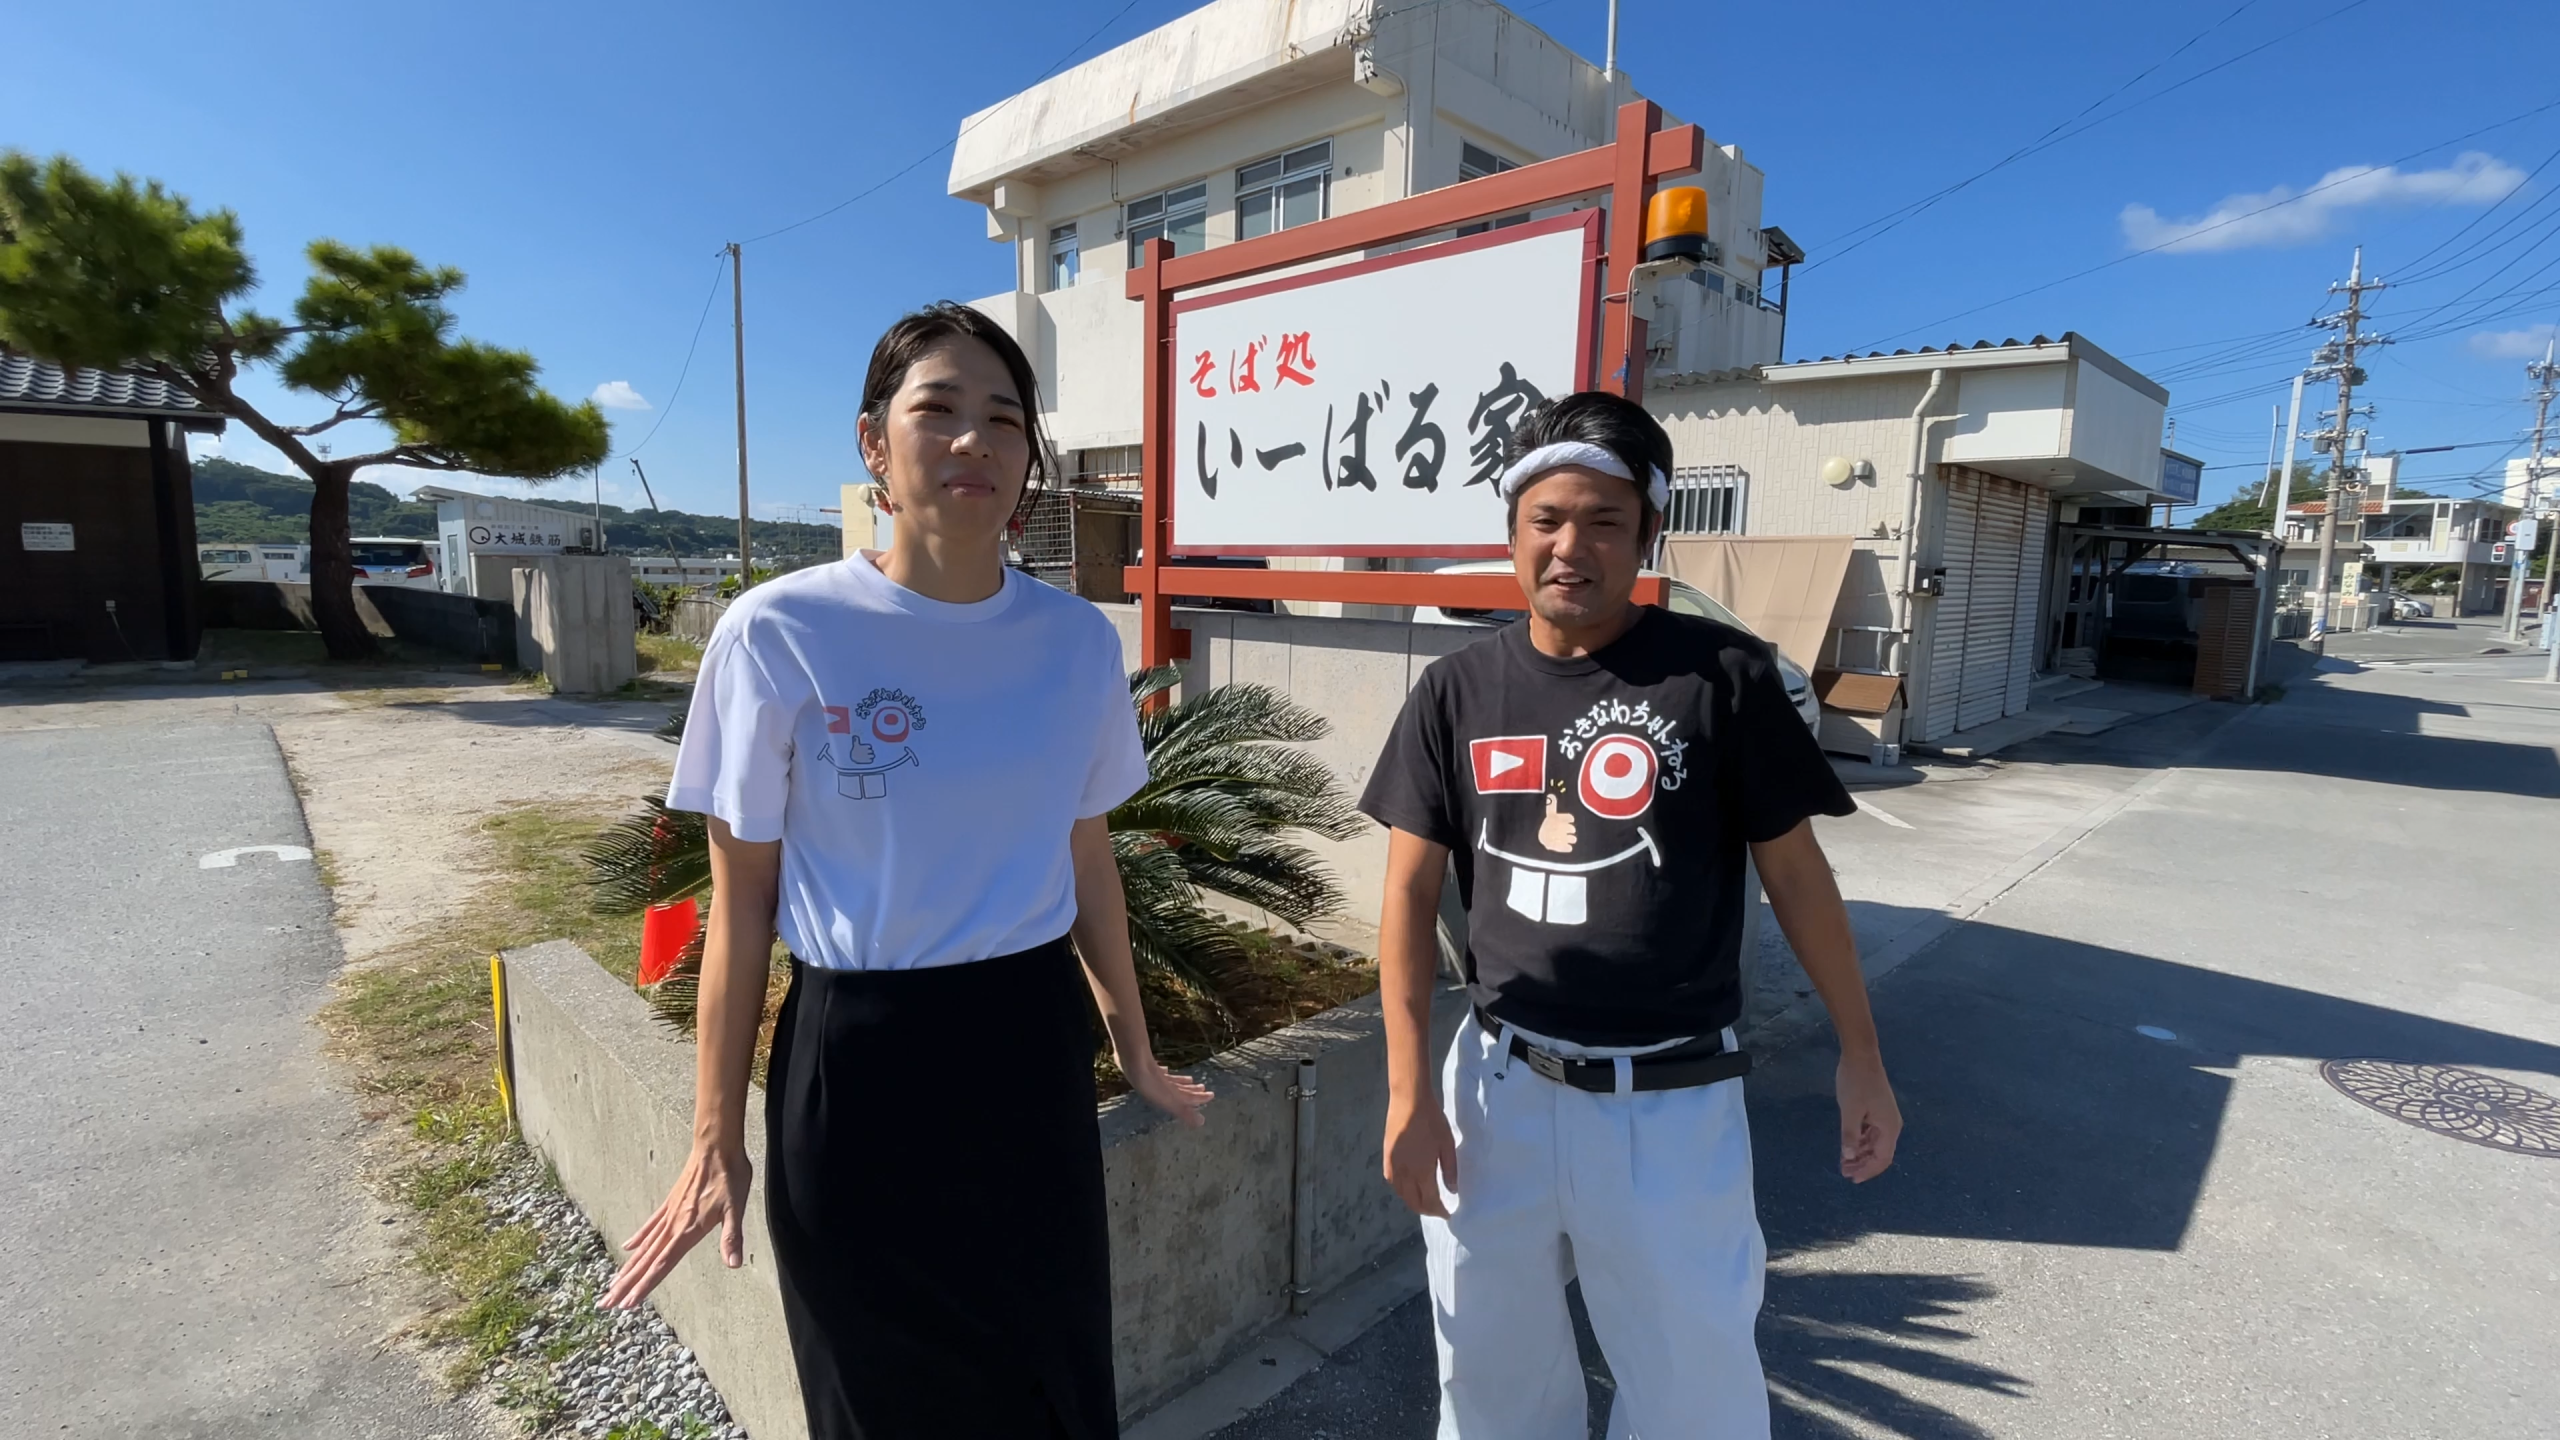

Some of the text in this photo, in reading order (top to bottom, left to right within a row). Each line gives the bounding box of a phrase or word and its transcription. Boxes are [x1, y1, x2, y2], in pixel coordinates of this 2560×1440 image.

[1189, 330, 1318, 398] そば処
[494, 532, 561, 547] 大城鉄筋
[1558, 698, 1689, 790] おきなわちゃんねる
